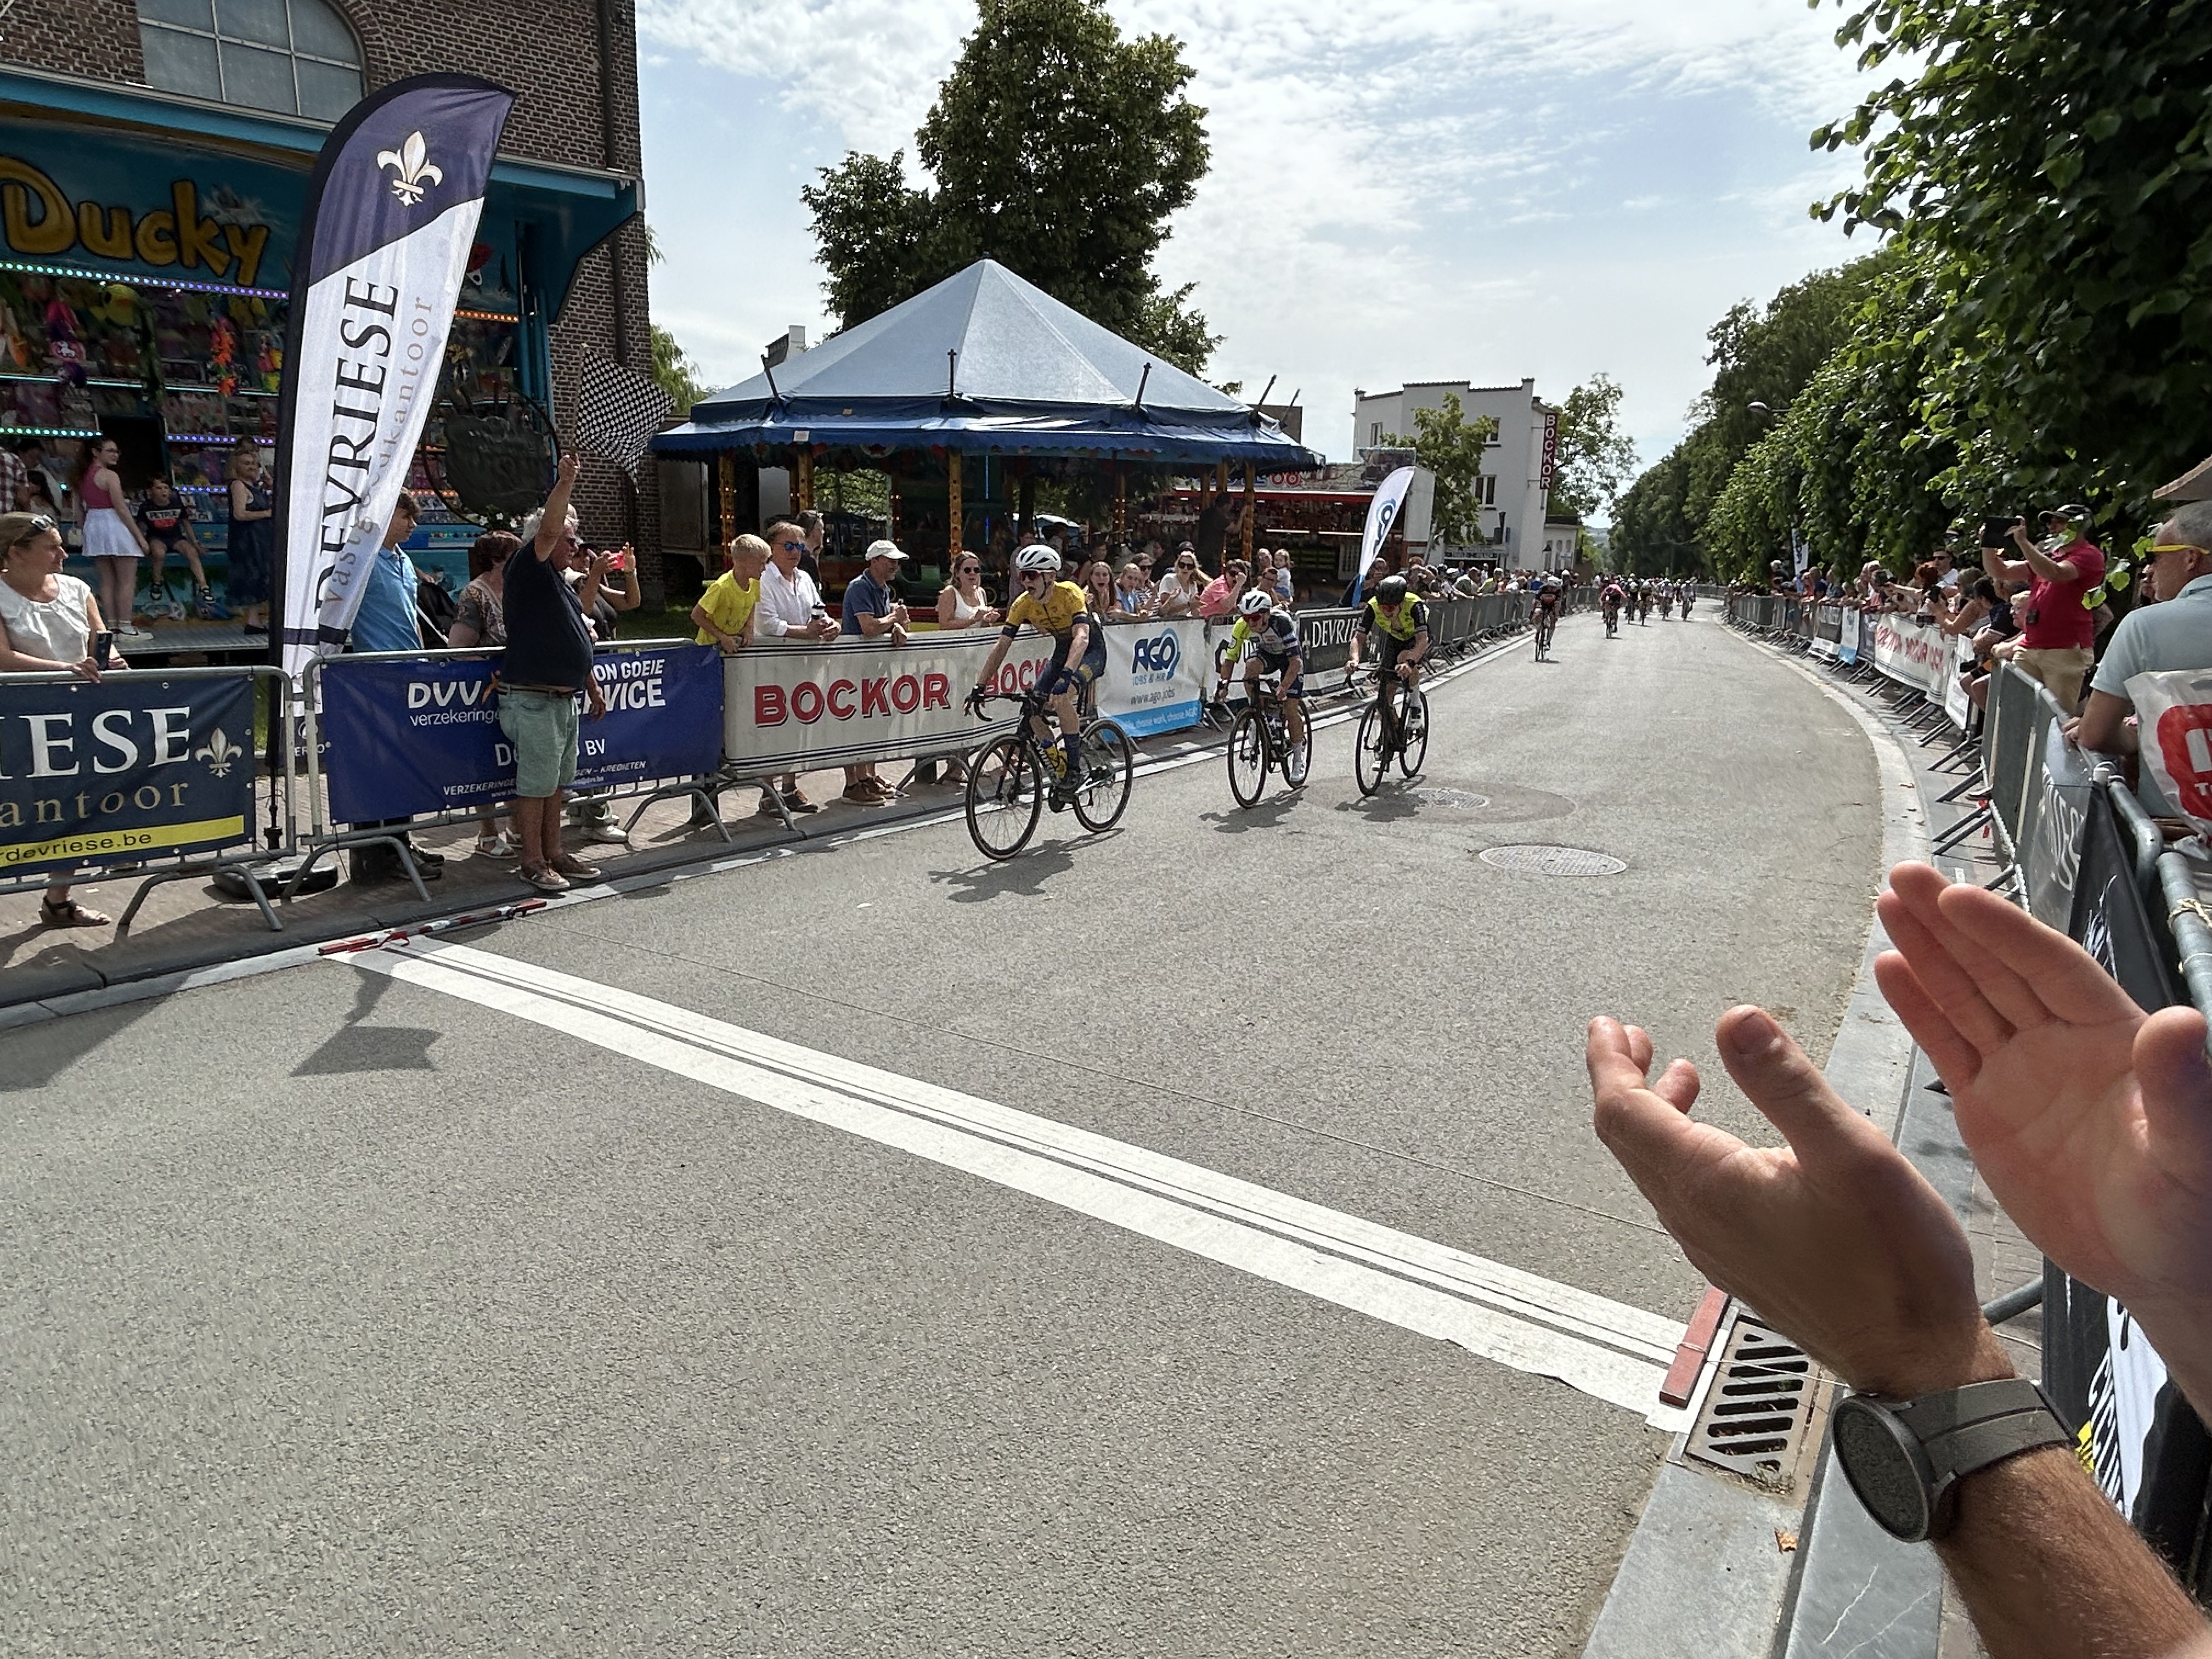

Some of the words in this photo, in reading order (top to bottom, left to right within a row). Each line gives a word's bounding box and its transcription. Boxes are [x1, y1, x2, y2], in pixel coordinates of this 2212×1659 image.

[0, 155, 271, 286] Ducky
[1541, 415, 1556, 488] BOCKOR
[620, 658, 665, 679] GOEIE
[408, 680, 482, 709] DVV
[754, 673, 951, 728] BOCKOR
[0, 707, 190, 779] ESE
[294, 744, 325, 757] ERO
[585, 738, 606, 756] BV
